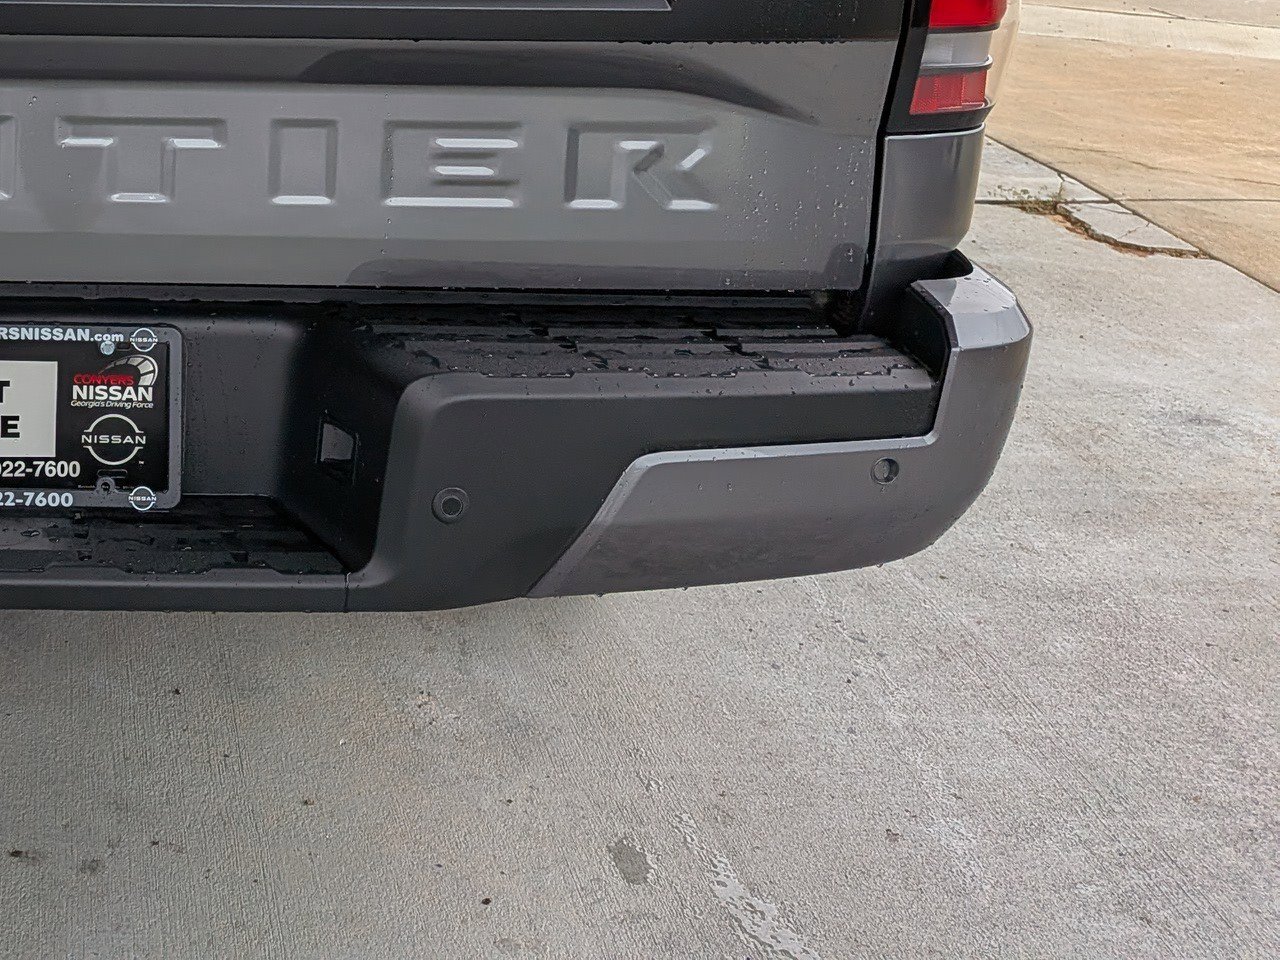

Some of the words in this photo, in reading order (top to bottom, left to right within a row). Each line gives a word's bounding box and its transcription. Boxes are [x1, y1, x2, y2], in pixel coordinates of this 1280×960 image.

[73, 373, 135, 386] CONYERS
[72, 385, 153, 401] NISSAN
[70, 400, 105, 409] Georgia's
[105, 401, 132, 409] Driving
[132, 401, 154, 409] Force
[81, 434, 147, 445] NISSAN
